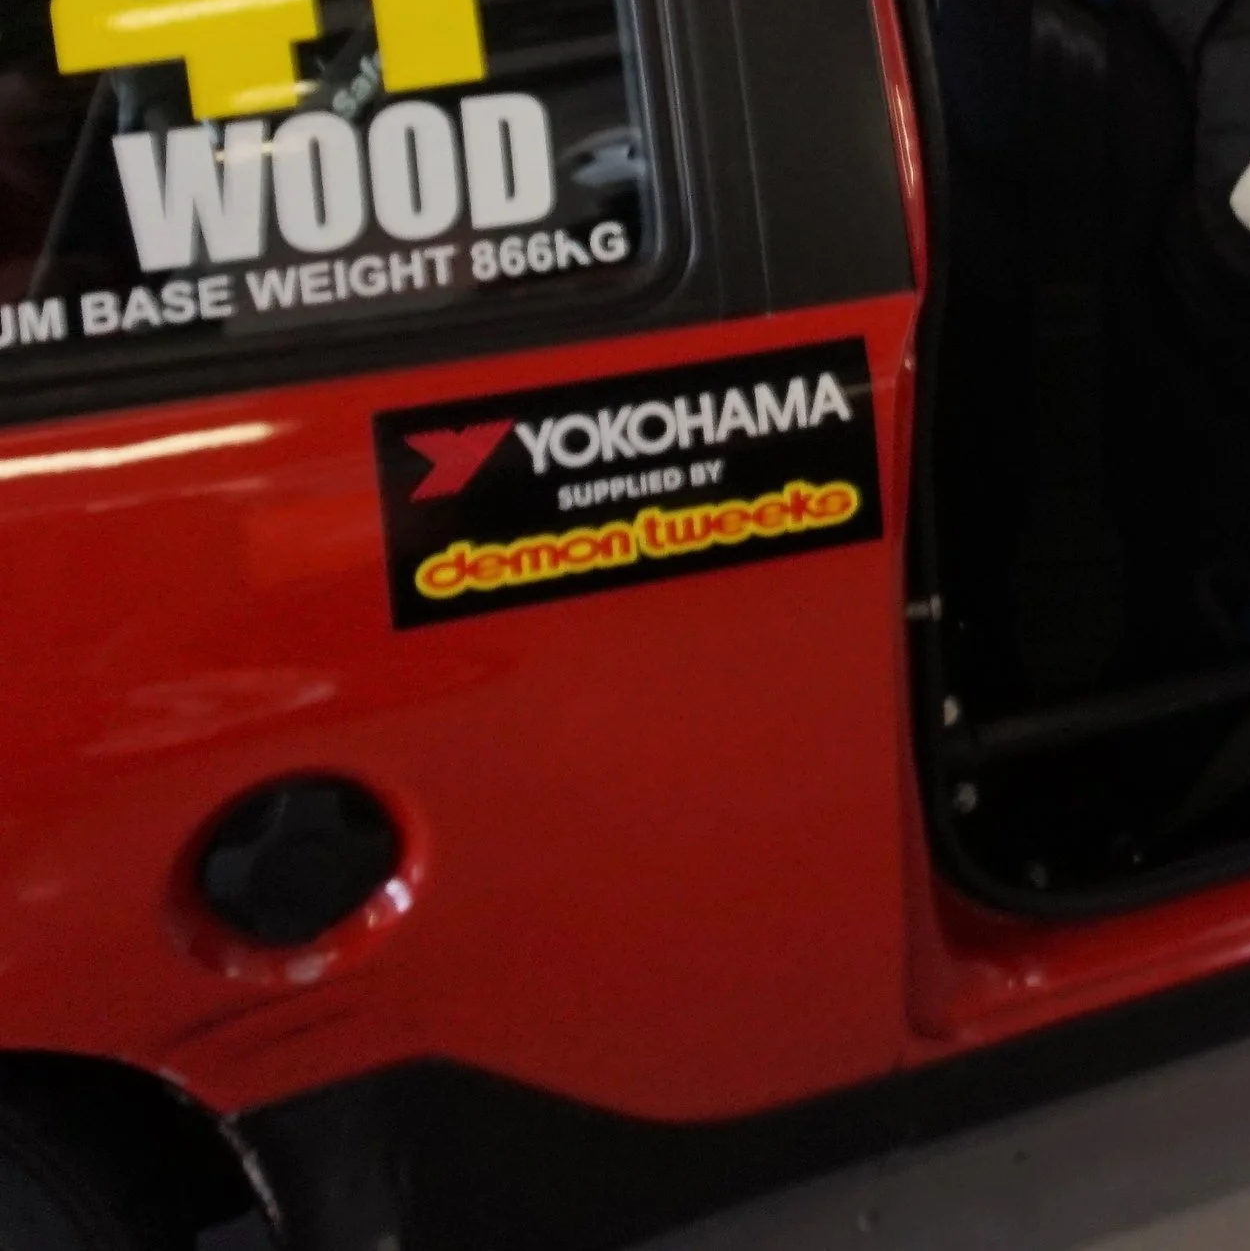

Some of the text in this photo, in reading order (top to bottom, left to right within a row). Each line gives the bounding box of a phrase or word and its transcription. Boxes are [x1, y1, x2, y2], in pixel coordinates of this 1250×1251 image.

[112, 92, 556, 273] WOOD
[80, 274, 236, 336] BASE
[245, 244, 456, 311] WEIGHT
[515, 372, 852, 475] YOKOHAMA
[557, 459, 724, 510] SUPPLIED BY
[415, 480, 859, 599] demon tweeks
